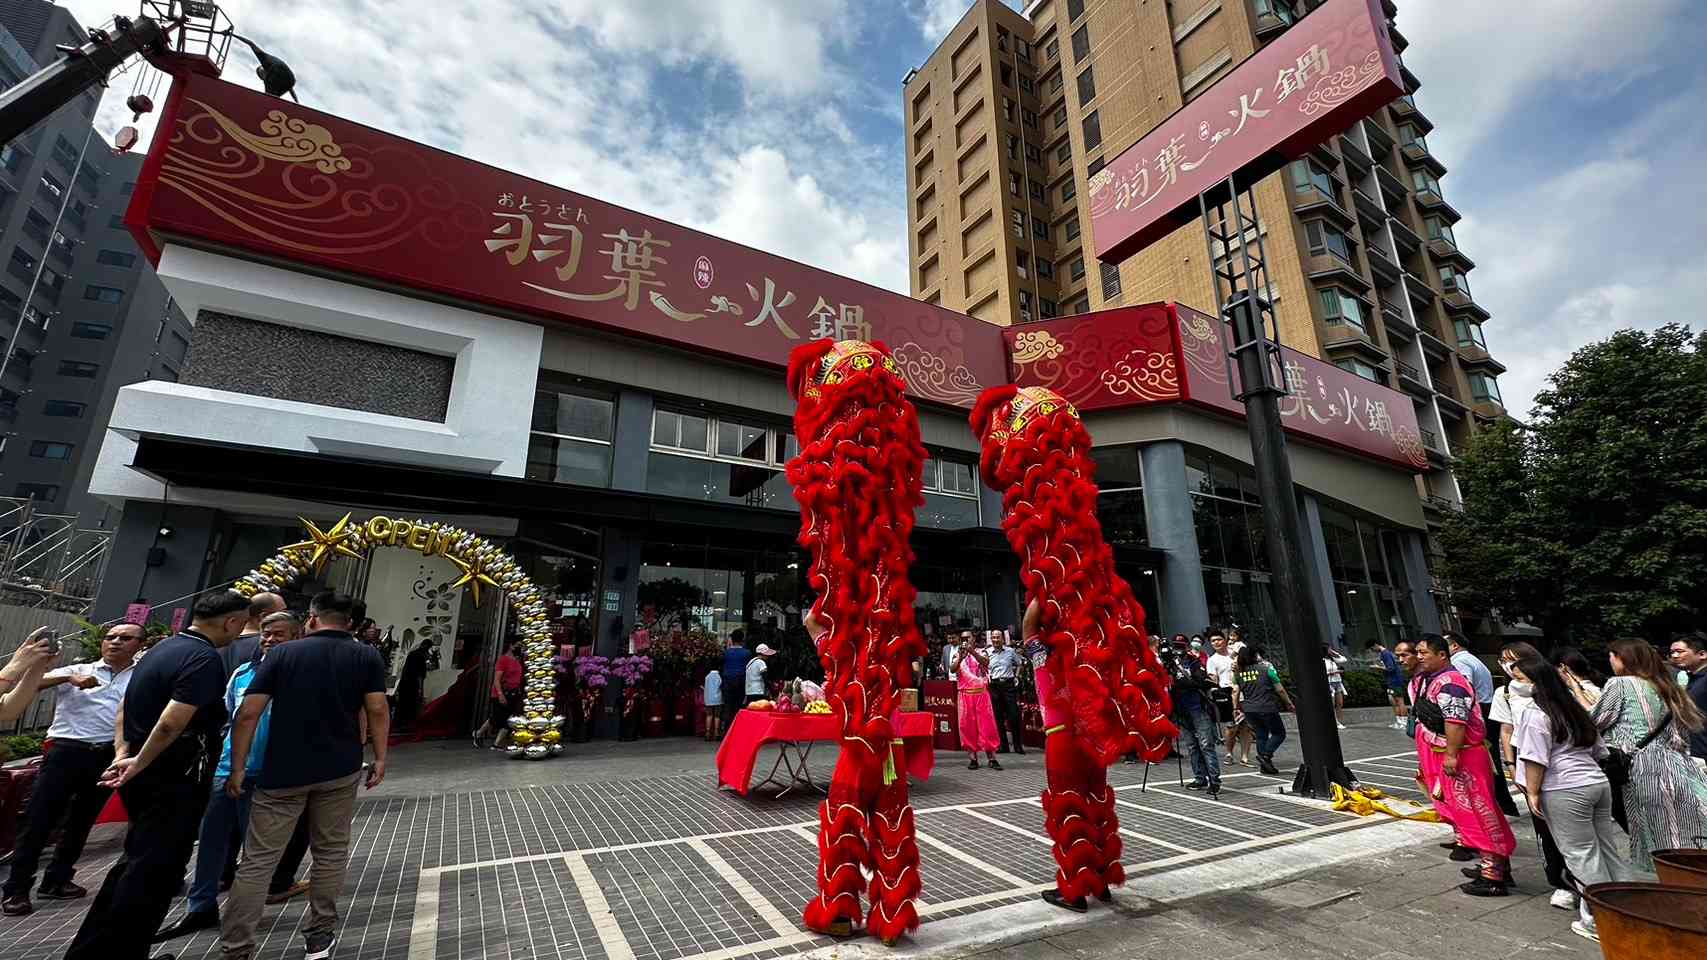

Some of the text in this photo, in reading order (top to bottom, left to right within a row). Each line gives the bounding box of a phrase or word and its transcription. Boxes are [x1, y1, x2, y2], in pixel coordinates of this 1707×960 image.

[498, 192, 591, 225] おとうさん
[368, 515, 450, 557] OPEN
